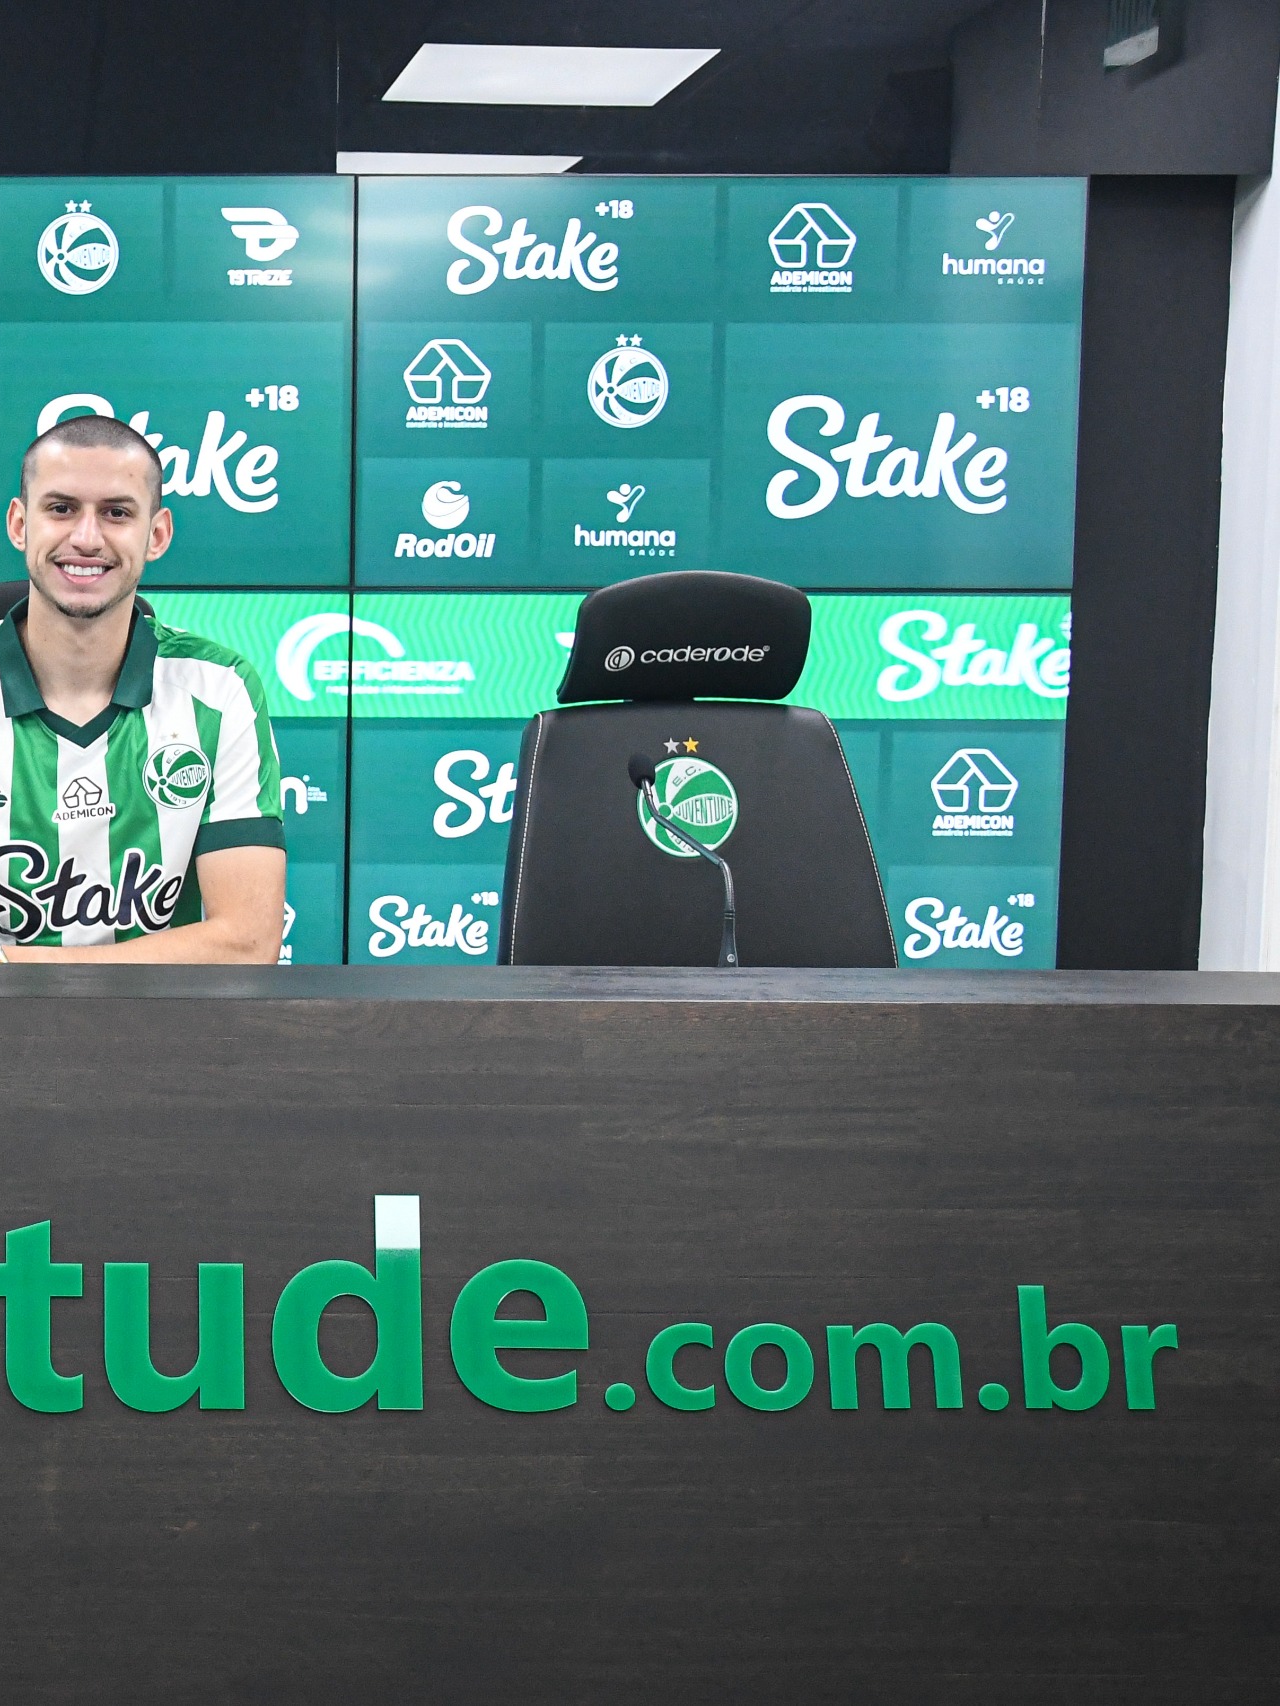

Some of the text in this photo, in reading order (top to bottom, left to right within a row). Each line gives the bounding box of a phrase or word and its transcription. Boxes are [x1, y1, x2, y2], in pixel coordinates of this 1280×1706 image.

[595, 199, 634, 219] +18
[446, 205, 619, 295] Stake
[942, 252, 1045, 275] humana
[770, 270, 853, 286] ADEMICON
[245, 384, 300, 412] +18
[976, 386, 1030, 413] +18
[406, 406, 488, 421] ADEMICON
[766, 394, 1008, 519] Stake
[394, 532, 496, 558] RodOil
[574, 524, 676, 547] humana
[876, 609, 1071, 702] Stake
[54, 805, 114, 821] ADEMICON
[675, 796, 733, 824] JUVENTUDE
[932, 815, 1014, 830] ADEMICON
[1007, 893, 1035, 908] +18
[369, 895, 488, 957] Stake
[904, 896, 1024, 959] Stake
